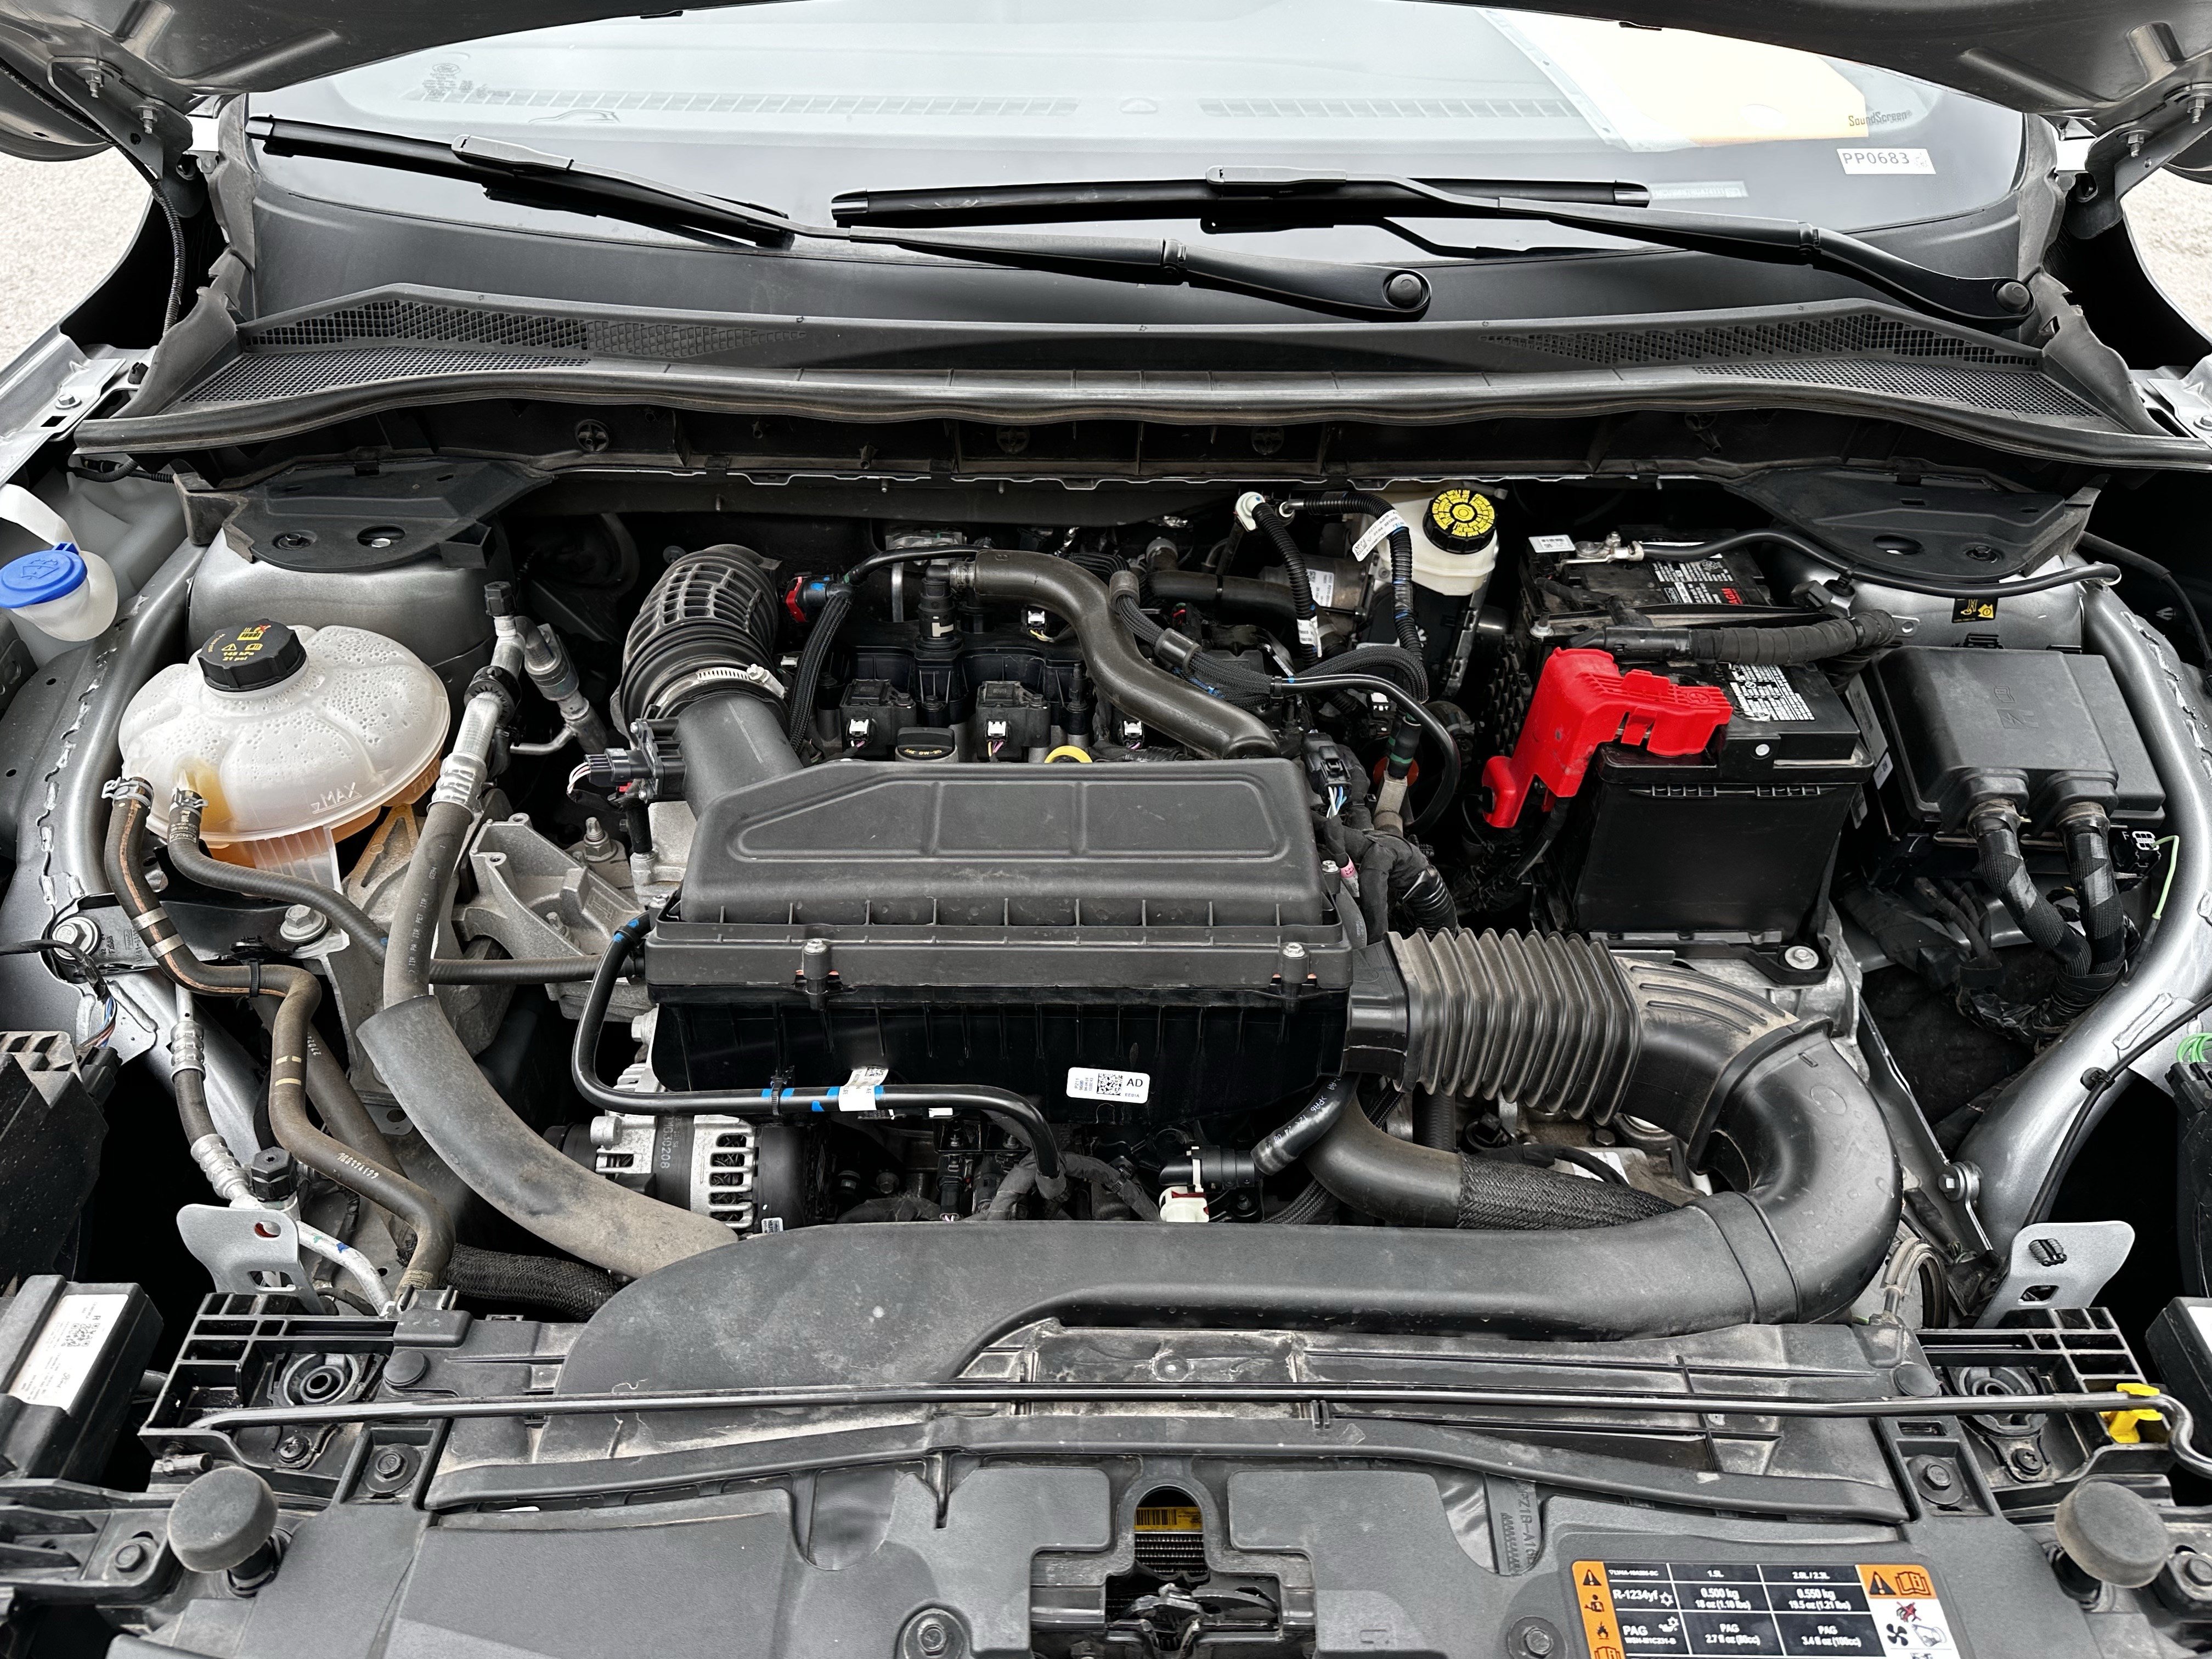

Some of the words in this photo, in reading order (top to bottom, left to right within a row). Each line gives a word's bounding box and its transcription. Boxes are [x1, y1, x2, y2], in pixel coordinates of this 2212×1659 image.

[1841, 151, 1910, 165] PP0683
[320, 782, 360, 807] MAX
[1126, 1078, 1143, 1087] AD
[1612, 1589, 1658, 1602] R-1234yf
[1700, 1587, 1725, 1598] 0.500
[1725, 1588, 1740, 1600] kg
[1796, 1588, 1822, 1599] 0.550
[1821, 1588, 1836, 1601] kg
[1622, 1625, 1649, 1637] PAG
[1719, 1623, 1740, 1633] PAG
[1817, 1624, 1838, 1635] PAG
